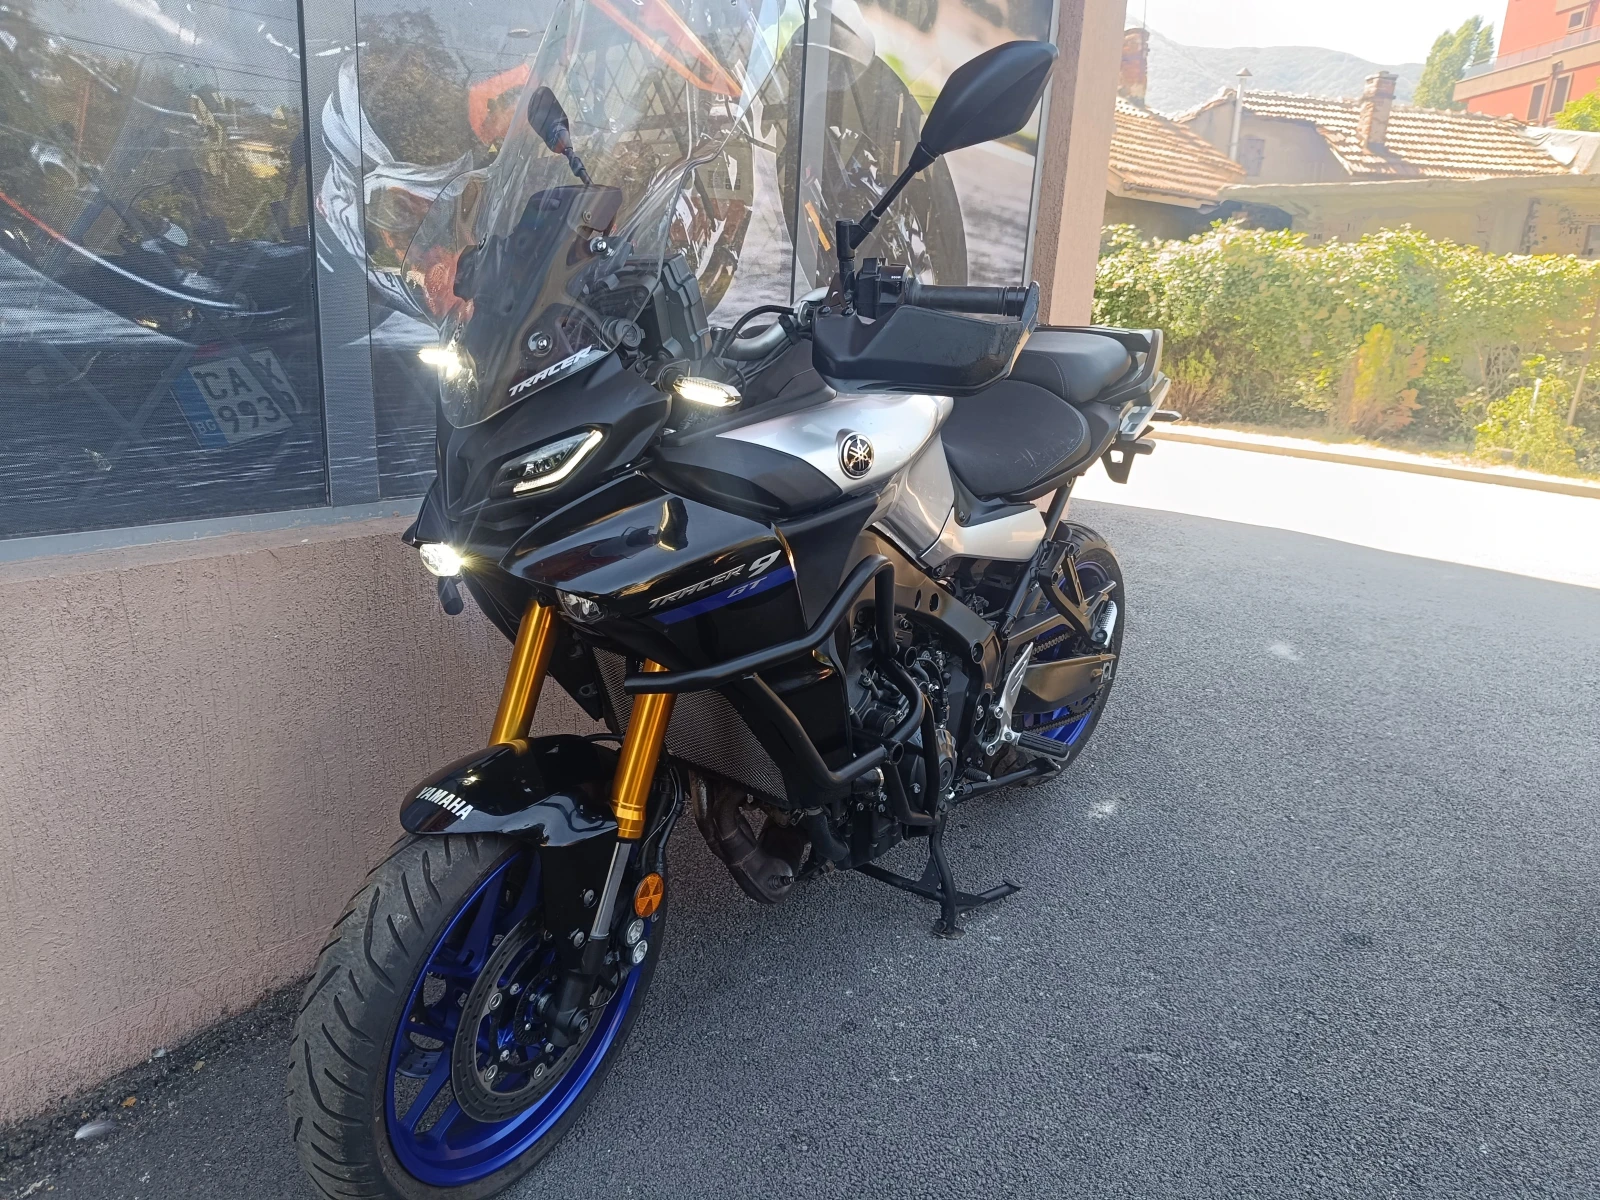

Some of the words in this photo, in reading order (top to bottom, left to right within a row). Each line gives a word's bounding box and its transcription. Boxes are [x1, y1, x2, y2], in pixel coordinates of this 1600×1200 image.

[193, 366, 253, 400] CA
[508, 344, 594, 397] TRACER
[648, 563, 746, 610] TRACER
[748, 549, 782, 579] 9
[726, 576, 767, 599] GT
[415, 786, 474, 821] YAMAHA
